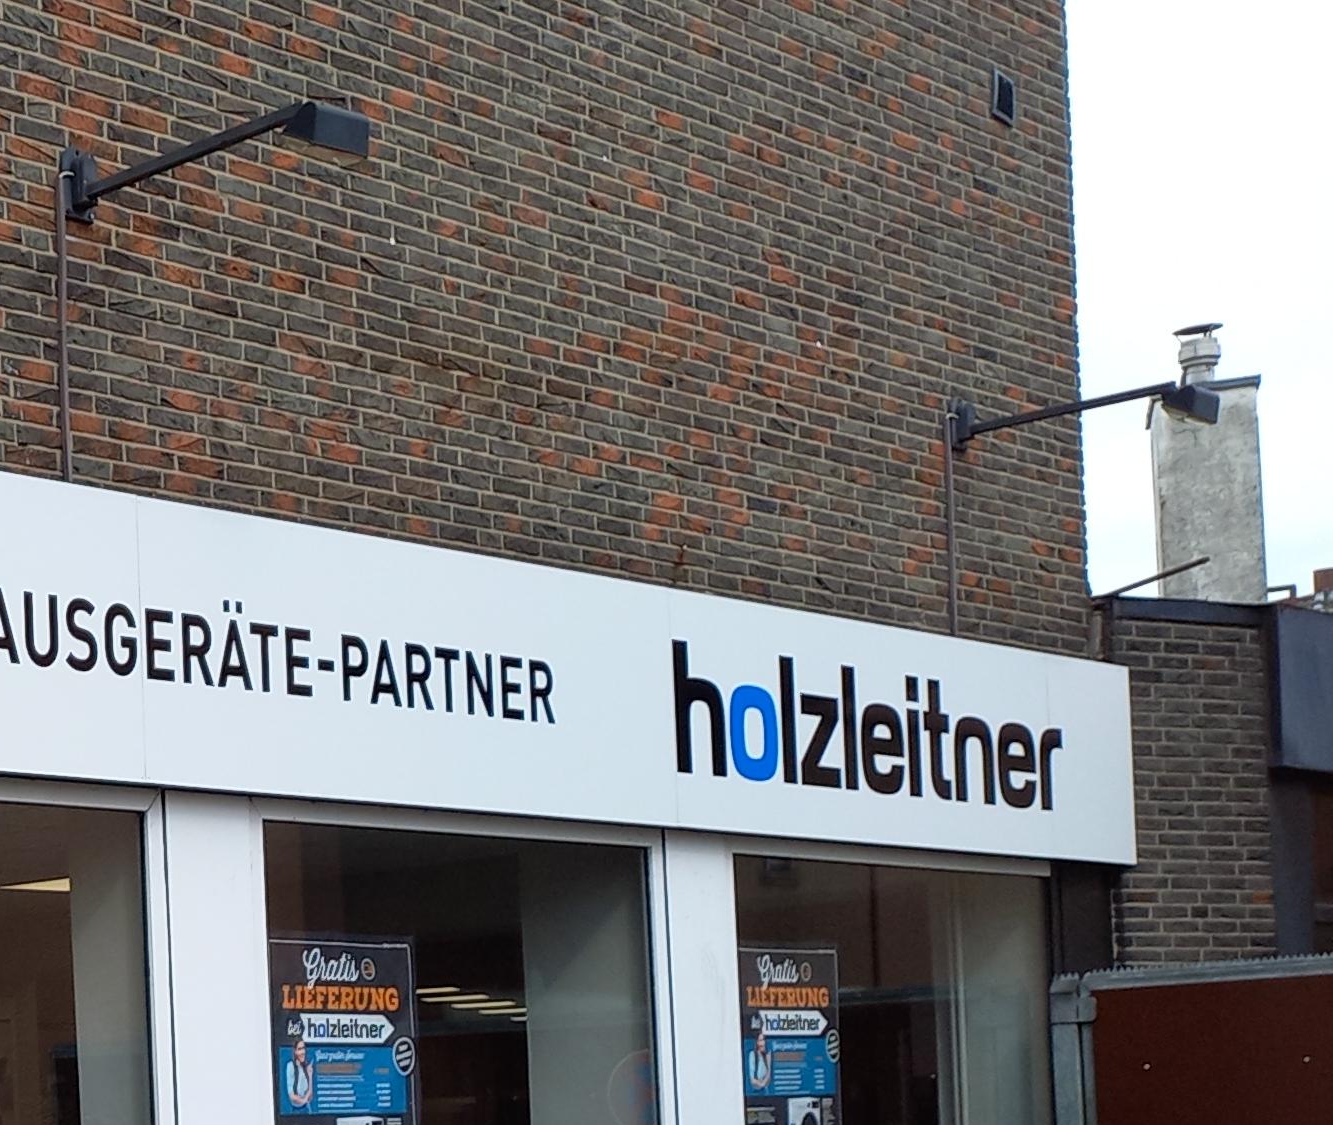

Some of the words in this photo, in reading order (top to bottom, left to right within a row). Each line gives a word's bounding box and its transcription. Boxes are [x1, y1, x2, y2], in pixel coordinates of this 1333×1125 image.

[672, 639, 1064, 811] holzleitner
[302, 947, 360, 990] Gratis
[757, 954, 799, 990] Gratis
[282, 984, 400, 1011] LIEFERUNG
[746, 986, 829, 1008] LIEFERUNG
[308, 1018, 385, 1038] holzleitner
[765, 1014, 821, 1030] holzleitner
